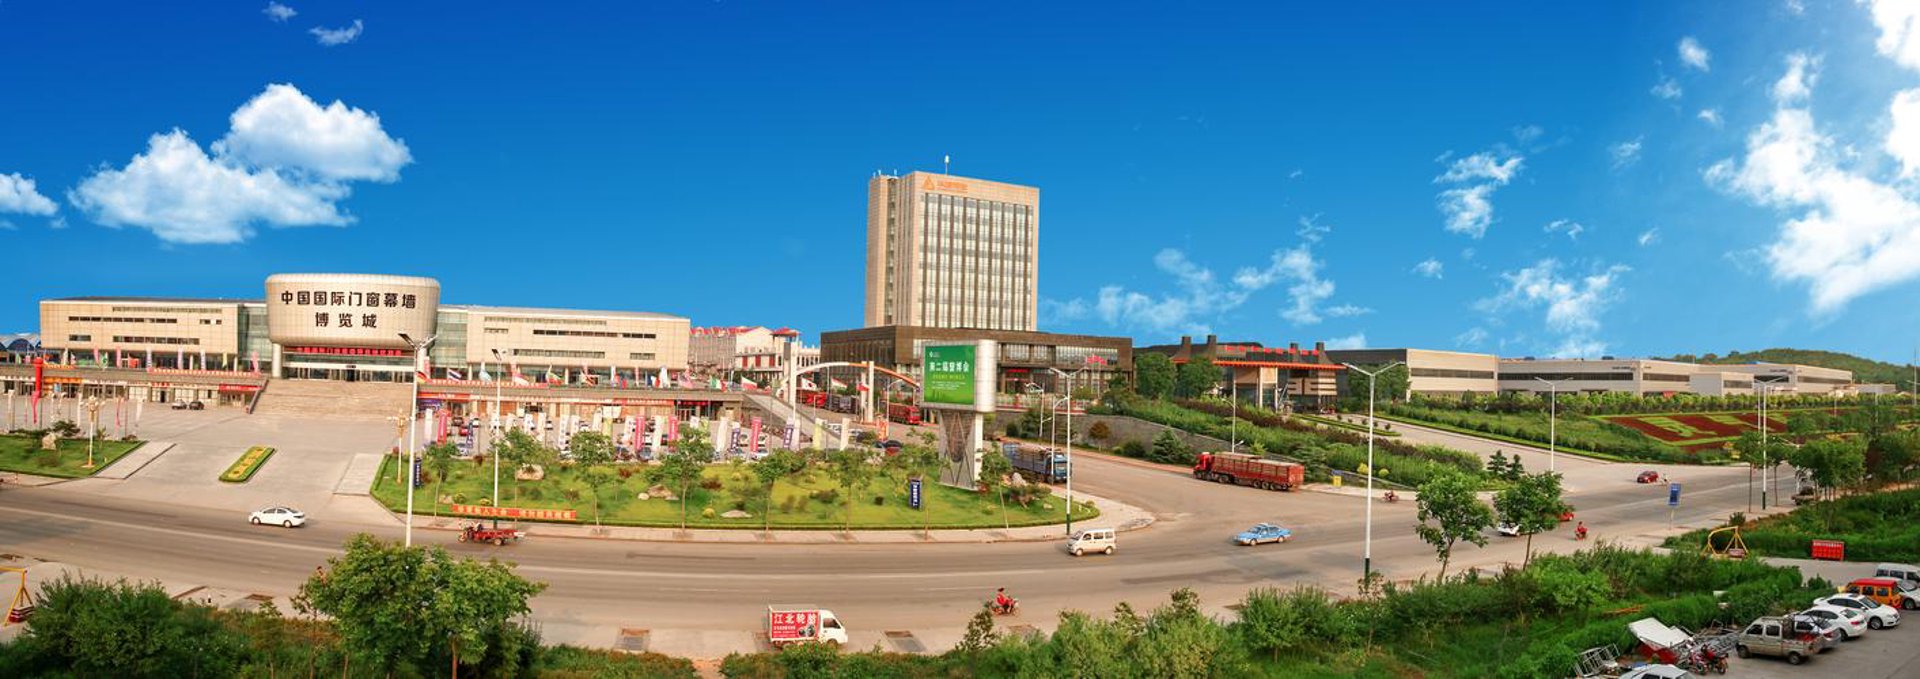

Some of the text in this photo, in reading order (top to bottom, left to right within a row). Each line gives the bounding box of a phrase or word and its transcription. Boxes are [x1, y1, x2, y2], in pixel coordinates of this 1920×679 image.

[281, 290, 417, 309] 中国国际门窗幕墙
[315, 312, 378, 328] 博览城
